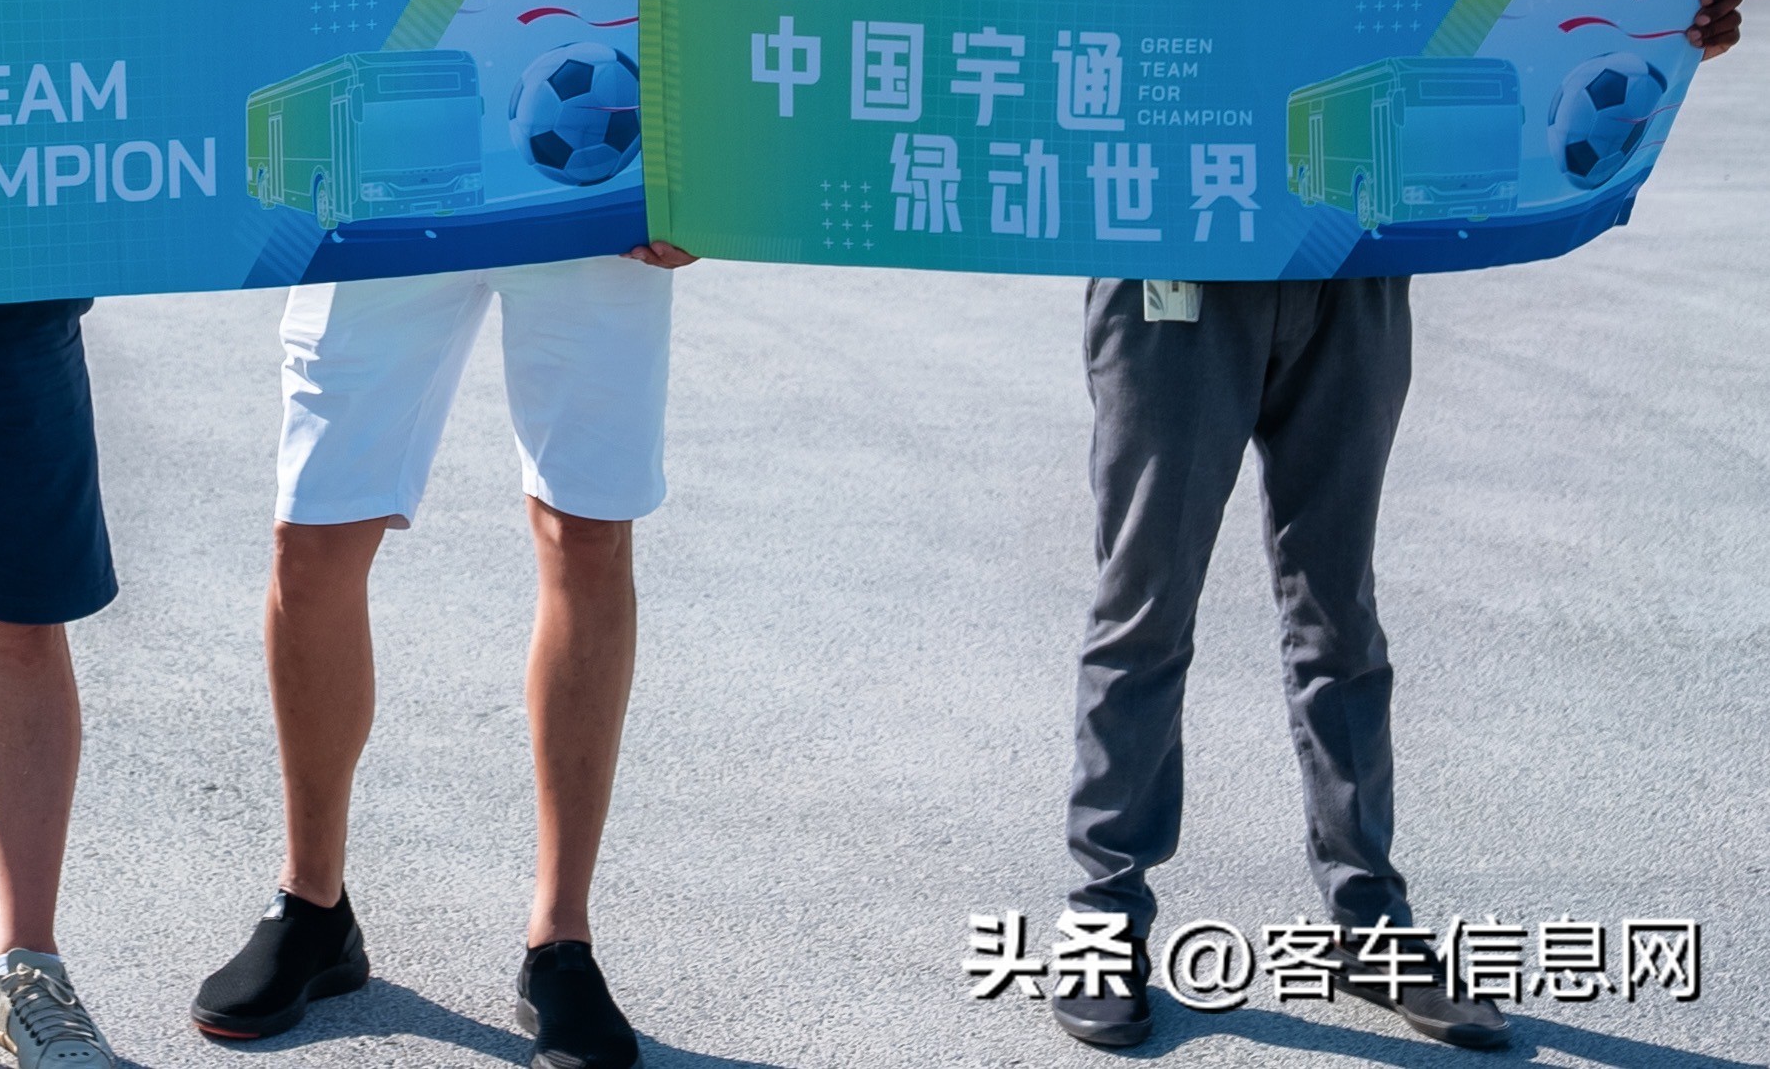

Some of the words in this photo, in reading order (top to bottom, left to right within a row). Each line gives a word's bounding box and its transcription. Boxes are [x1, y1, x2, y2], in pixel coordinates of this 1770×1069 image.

[1140, 37, 1214, 54] GREEN
[750, 15, 1126, 131] 中国宇通
[1138, 61, 1199, 78] TEAM
[1137, 84, 1181, 101] FOR
[1136, 109, 1254, 127] CHAMPION
[888, 131, 1262, 243] 绿动世界
